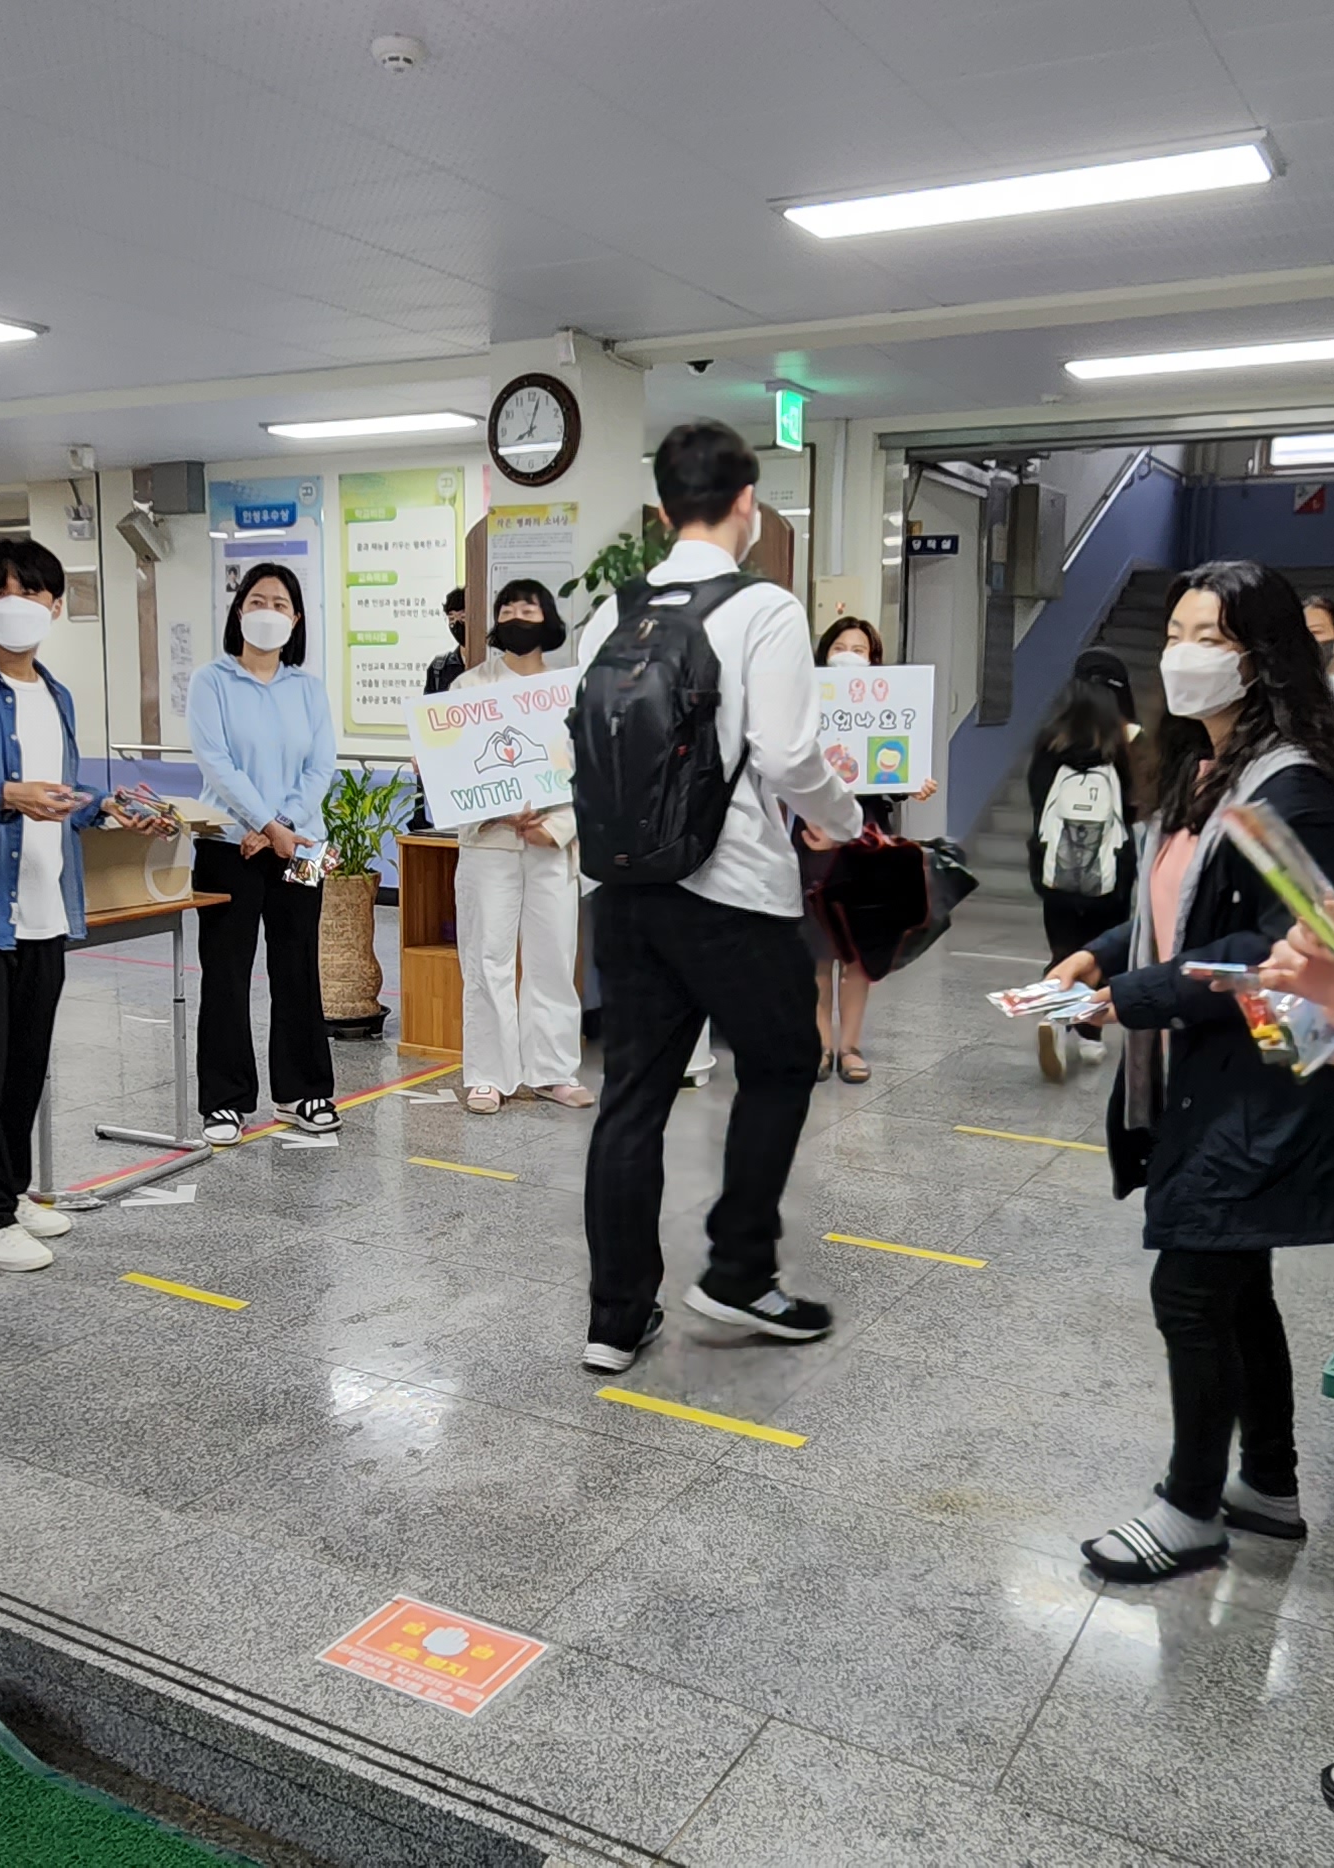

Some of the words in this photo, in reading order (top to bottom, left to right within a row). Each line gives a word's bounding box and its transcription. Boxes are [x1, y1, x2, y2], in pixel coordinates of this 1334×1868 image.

[242, 509, 290, 524] 인성우수상
[543, 515, 569, 527] 소녀상
[392, 541, 410, 550] 키우는
[413, 540, 432, 550] 행복한
[434, 538, 447, 548] 학교
[357, 598, 370, 608] 바른
[372, 598, 391, 608] 인성과
[393, 597, 411, 607] 능력을
[421, 608, 445, 617] 인재육
[361, 662, 386, 671] 인성교육
[388, 662, 413, 671] 프로그램
[427, 699, 503, 731] LOVE
[513, 684, 571, 715] YOU
[450, 777, 523, 811] WITH
[535, 768, 574, 794] YO
[346, 1658, 392, 1681] 마스크
